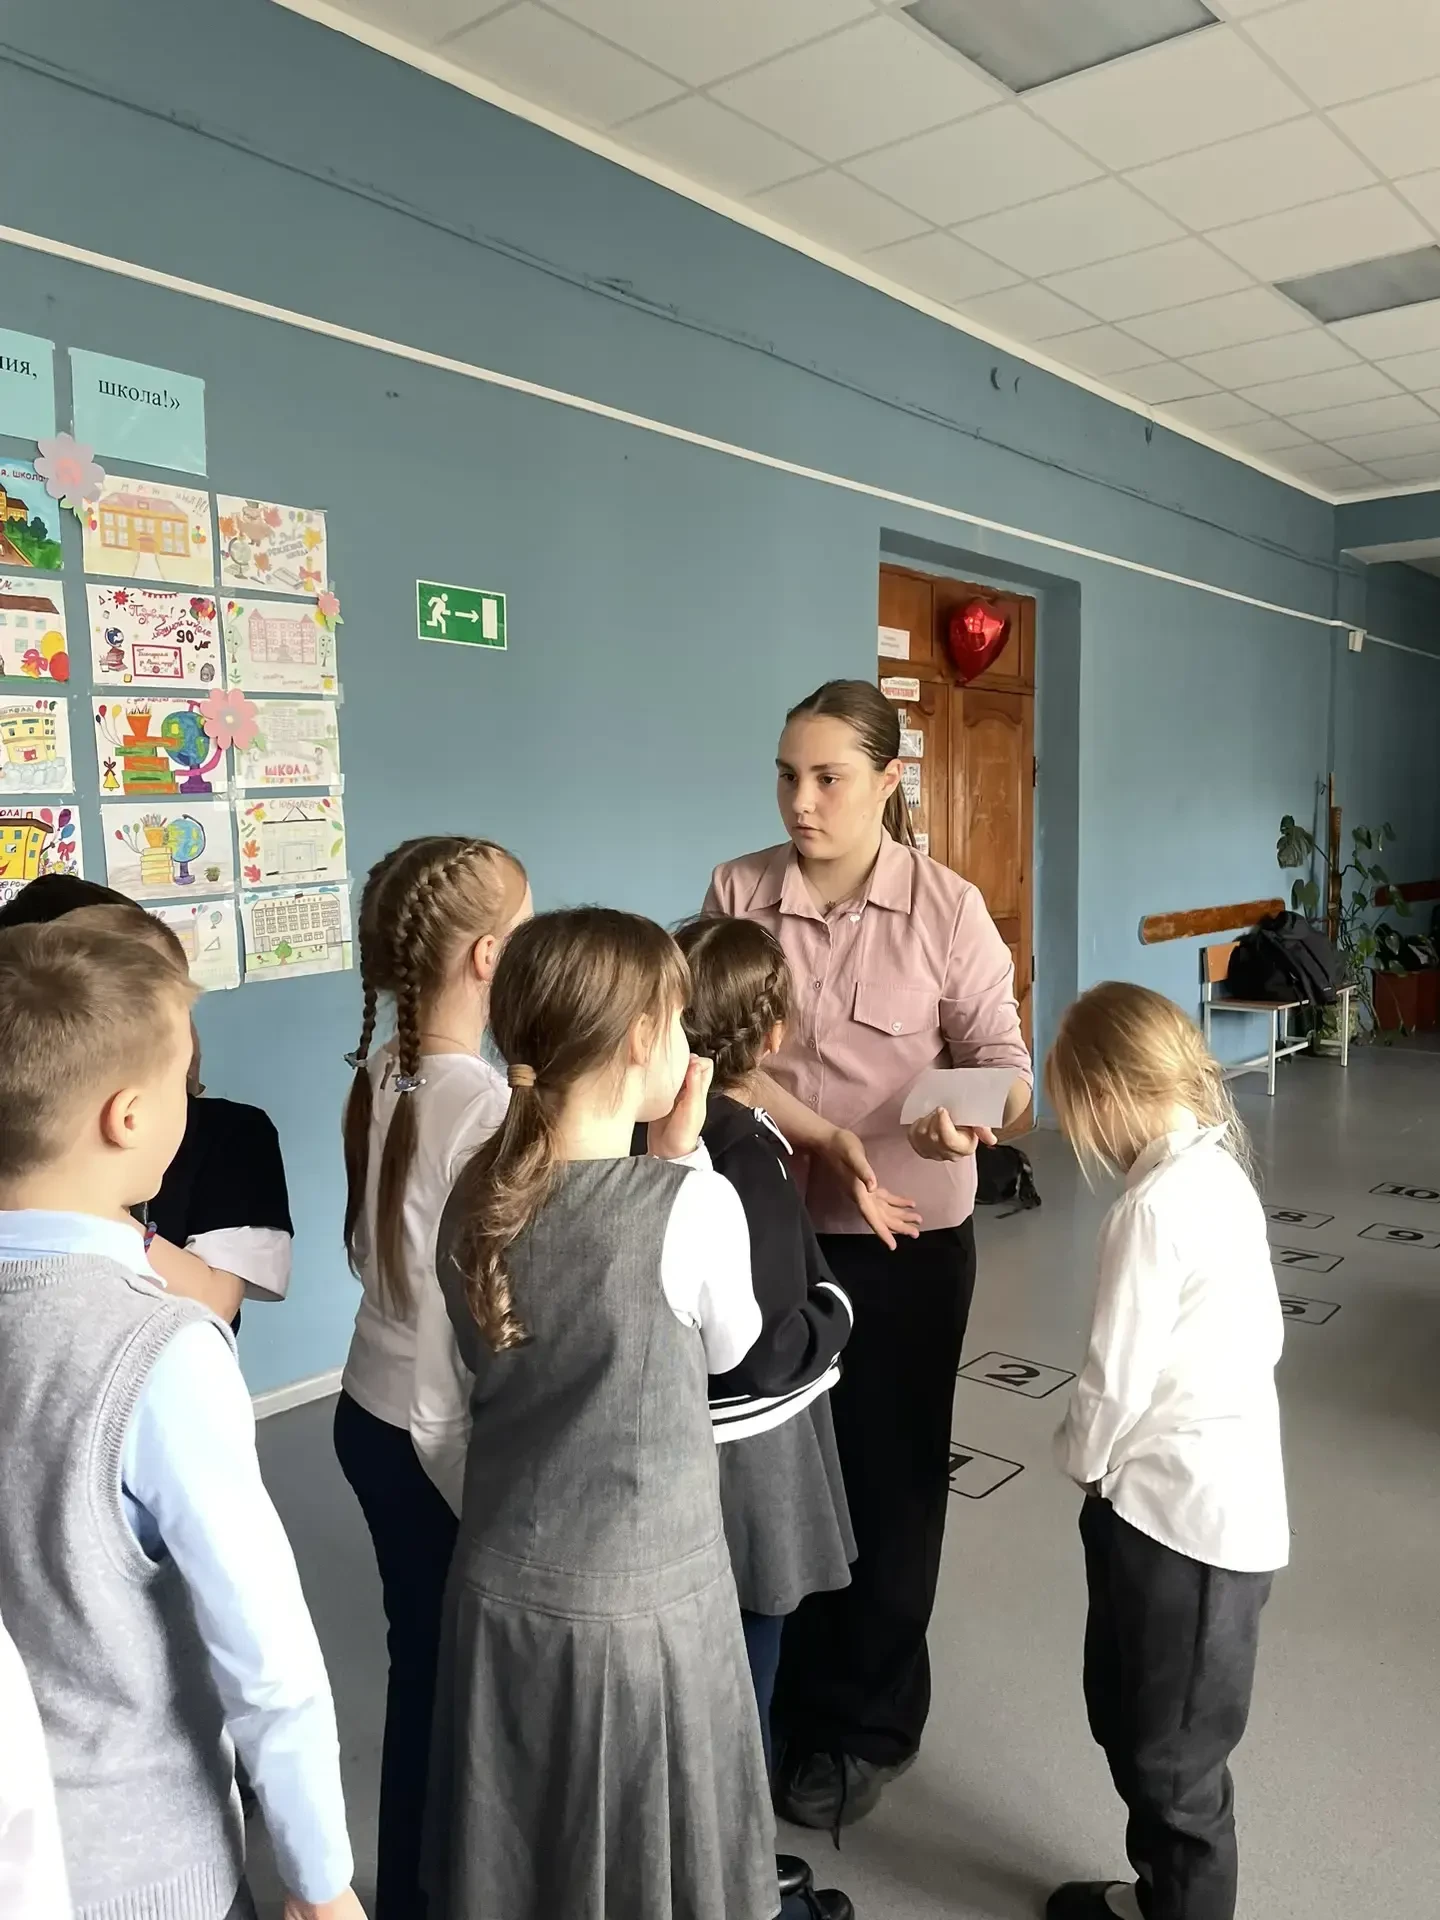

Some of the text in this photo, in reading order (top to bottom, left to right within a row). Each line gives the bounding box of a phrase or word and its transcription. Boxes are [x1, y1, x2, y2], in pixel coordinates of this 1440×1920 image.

[0, 355, 38, 380] ия,
[98, 379, 181, 409] школа!»
[176, 630, 194, 643] 90
[264, 764, 310, 776] ШКОЛА
[1380, 1185, 1440, 1200] 10
[1270, 1211, 1307, 1222] 8
[1385, 1230, 1424, 1241] 9
[1280, 1250, 1320, 1264] 7
[984, 1364, 1040, 1387] 2
